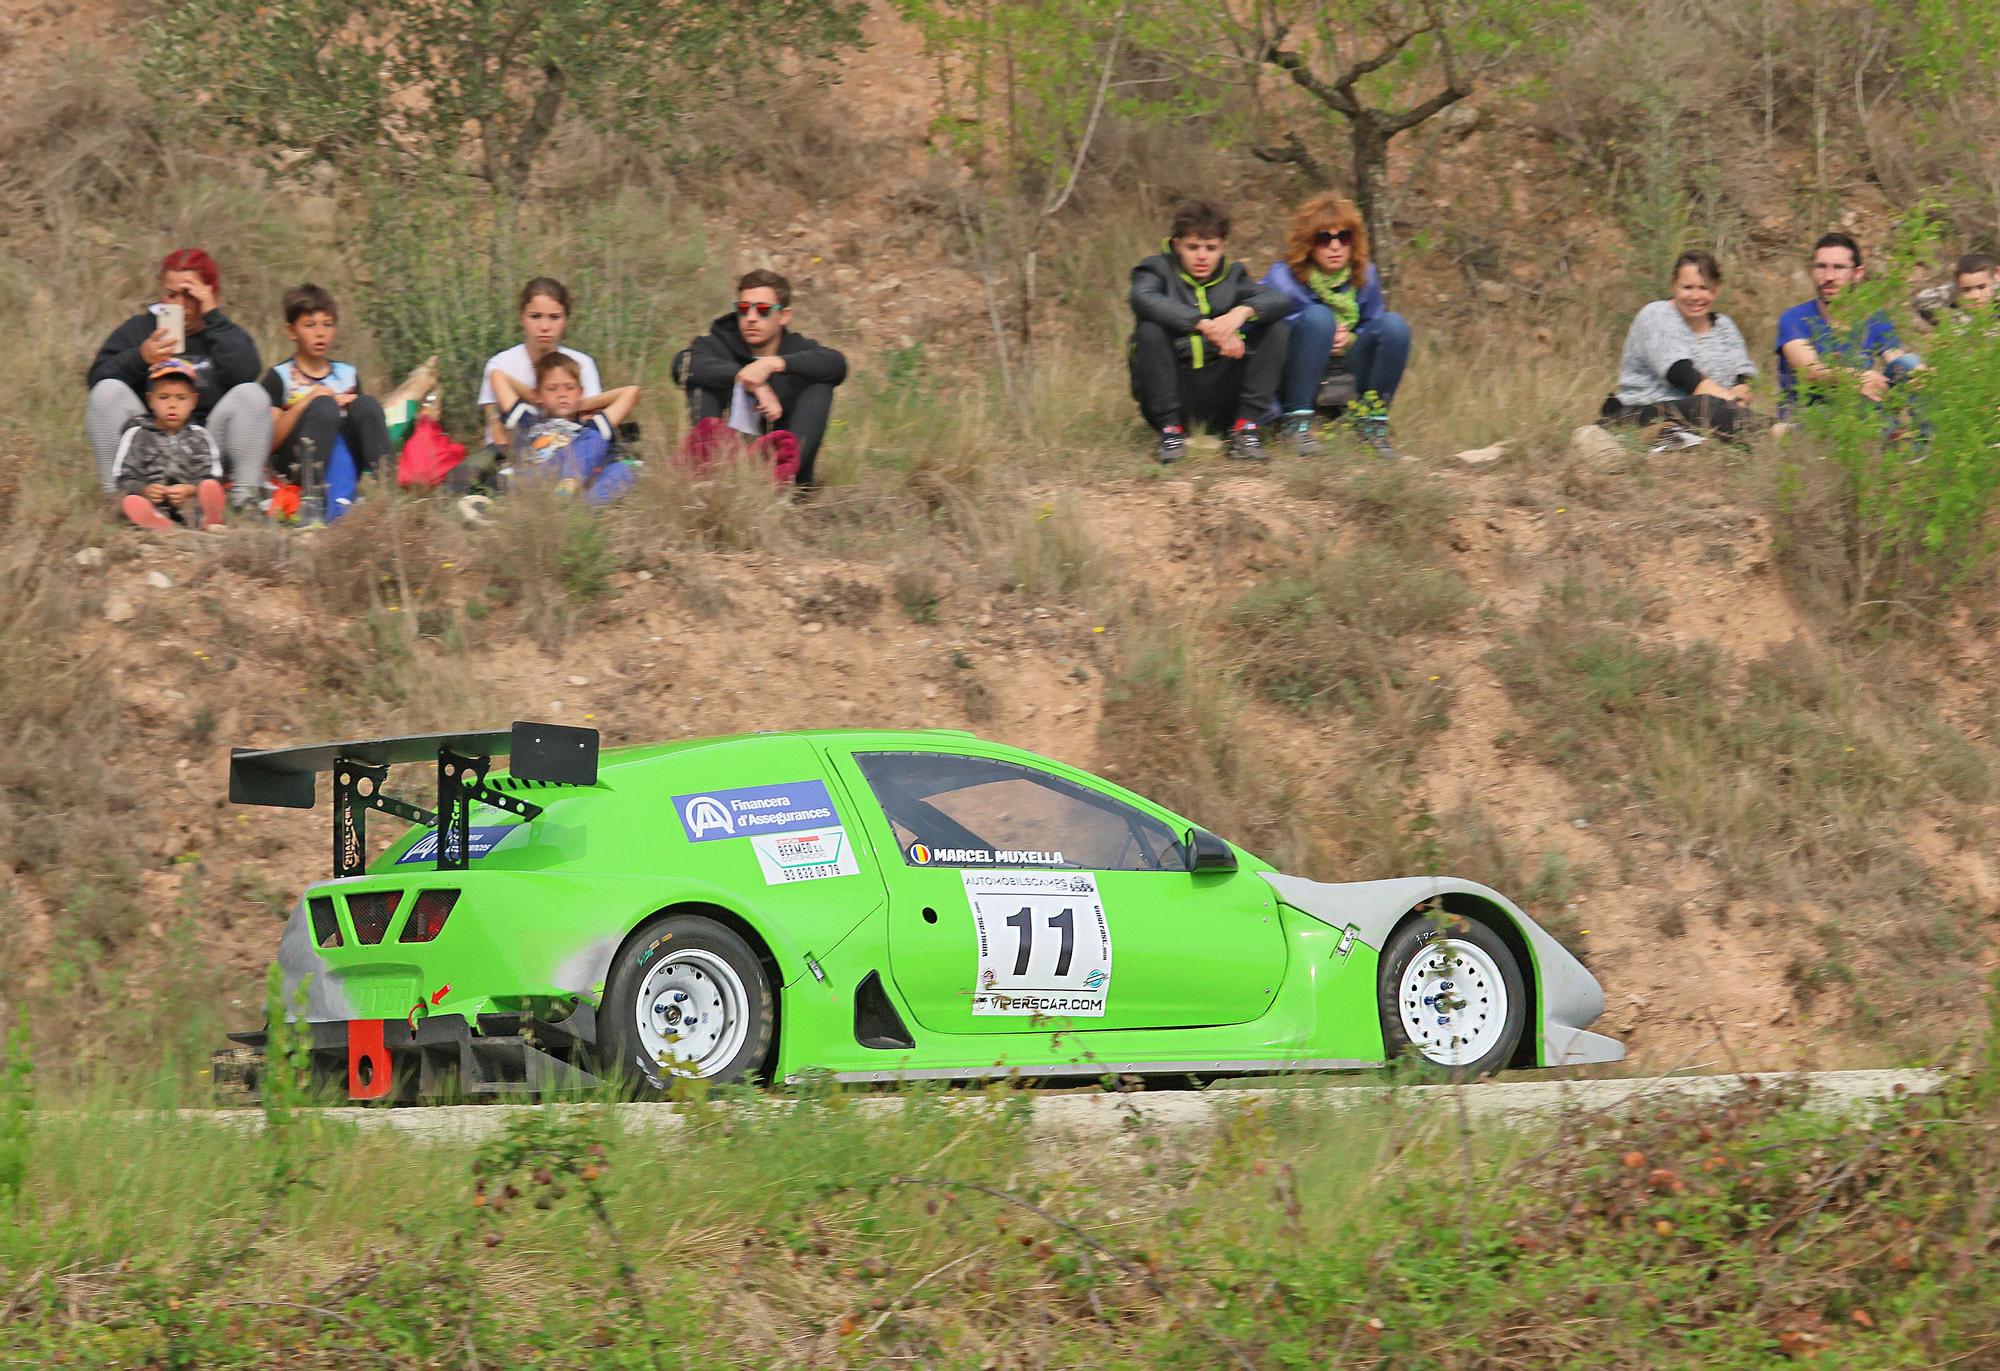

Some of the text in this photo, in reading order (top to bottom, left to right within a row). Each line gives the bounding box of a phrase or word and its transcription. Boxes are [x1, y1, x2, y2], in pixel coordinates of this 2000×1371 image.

[730, 796, 791, 812] Financera
[737, 807, 831, 826] d'Assegurances
[934, 849, 1065, 864] MARCEL MUXELLA
[1006, 907, 1074, 977] 11
